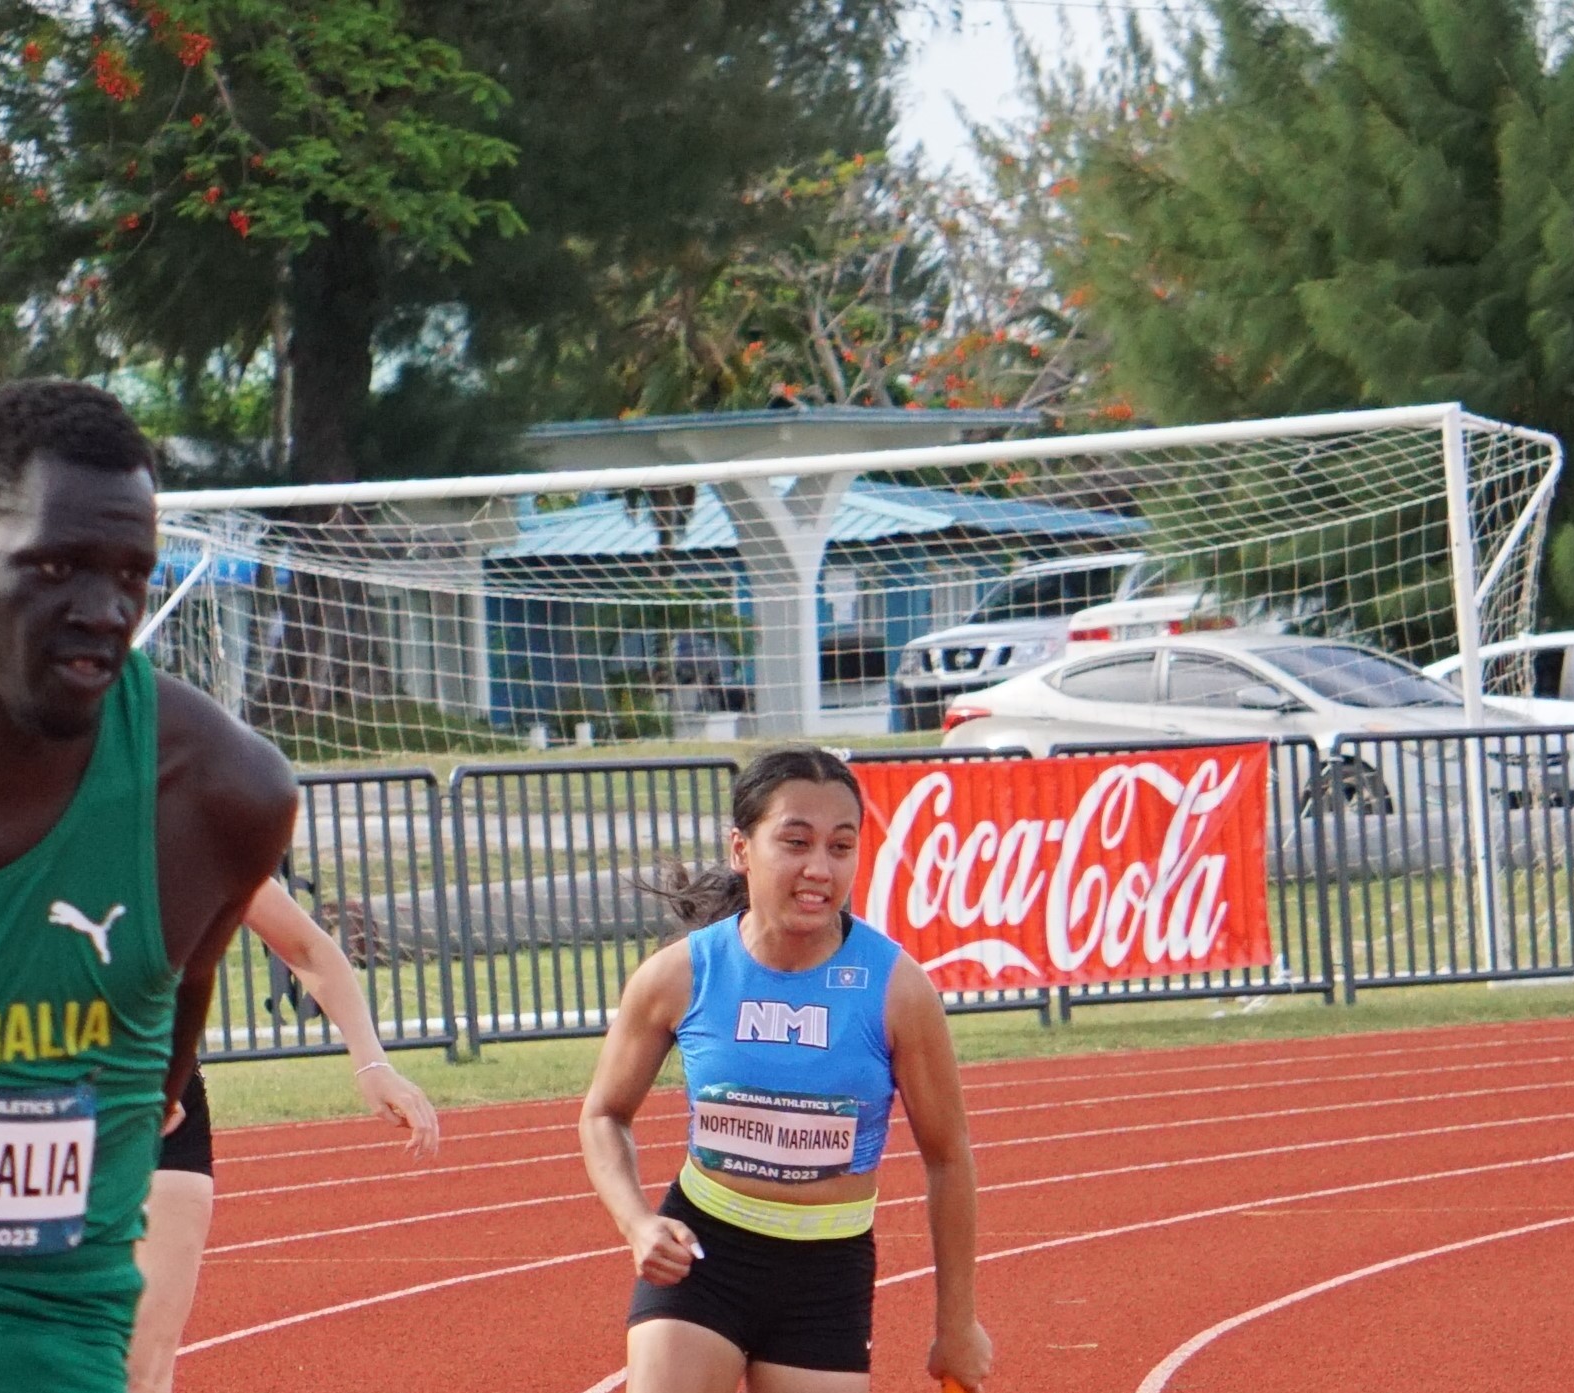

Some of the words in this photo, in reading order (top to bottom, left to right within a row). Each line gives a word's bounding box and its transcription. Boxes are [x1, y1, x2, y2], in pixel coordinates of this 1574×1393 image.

[865, 757, 1243, 974] Coca-Cola
[735, 1000, 829, 1050] NMI
[726, 1091, 773, 1106] OCEANIA
[774, 1097, 829, 1111] ATHLETICS
[700, 1114, 774, 1146] NORTHERN
[777, 1127, 850, 1150] MARIANAS
[723, 1158, 779, 1178] SAIPAN
[782, 1169, 818, 1180] 2023
